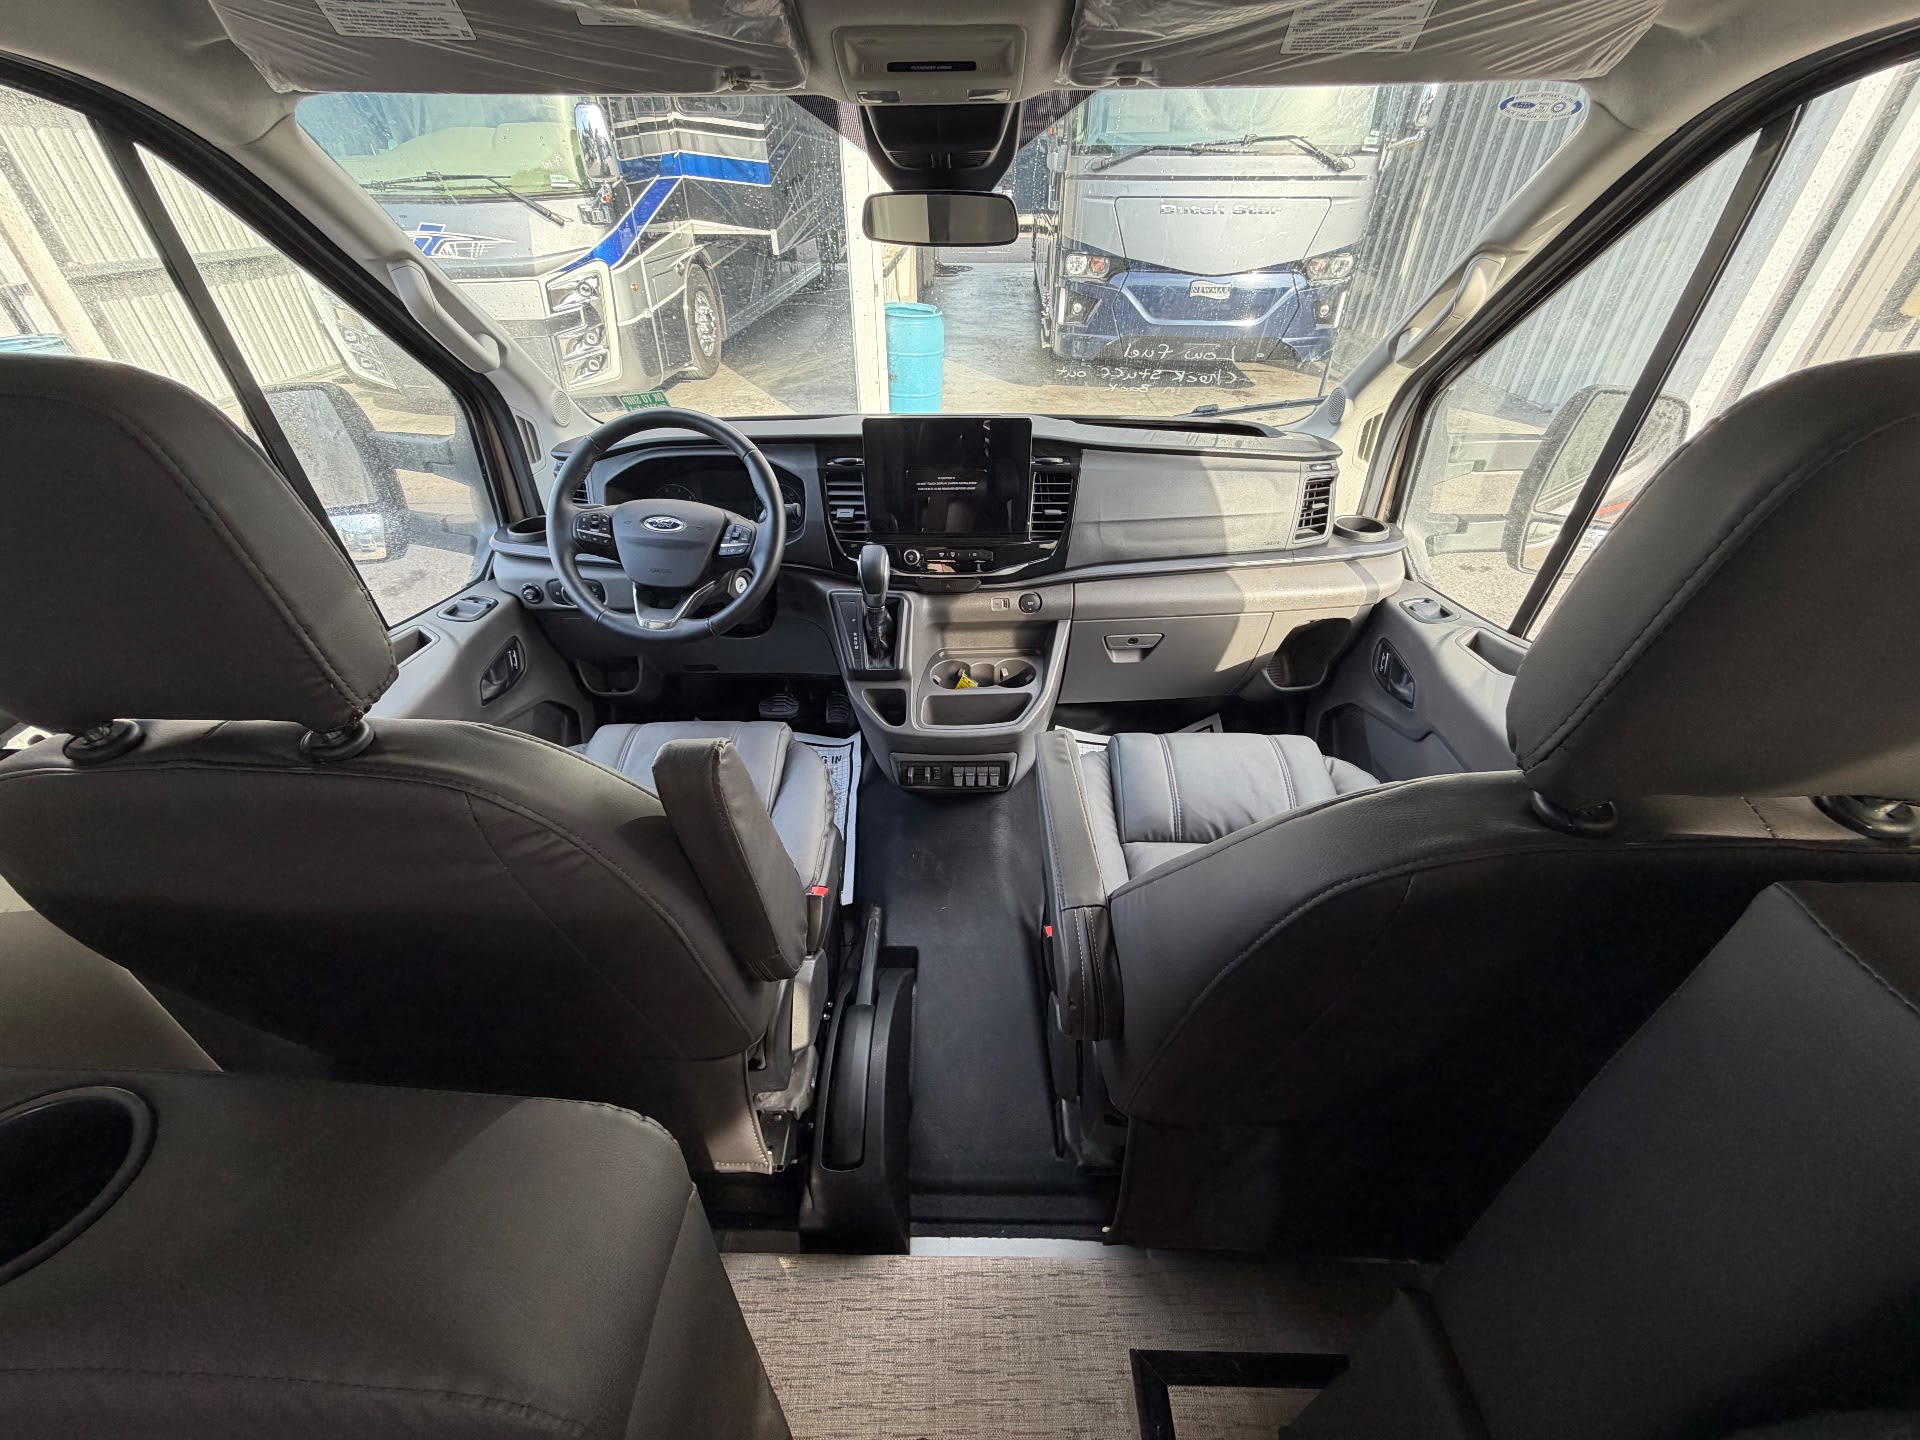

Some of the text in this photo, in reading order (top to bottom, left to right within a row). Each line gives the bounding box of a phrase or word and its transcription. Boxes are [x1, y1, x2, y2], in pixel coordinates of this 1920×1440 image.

[1160, 204, 1282, 215] Dutch Star
[1191, 286, 1231, 294] NEWMAR
[831, 755, 842, 764] IN
